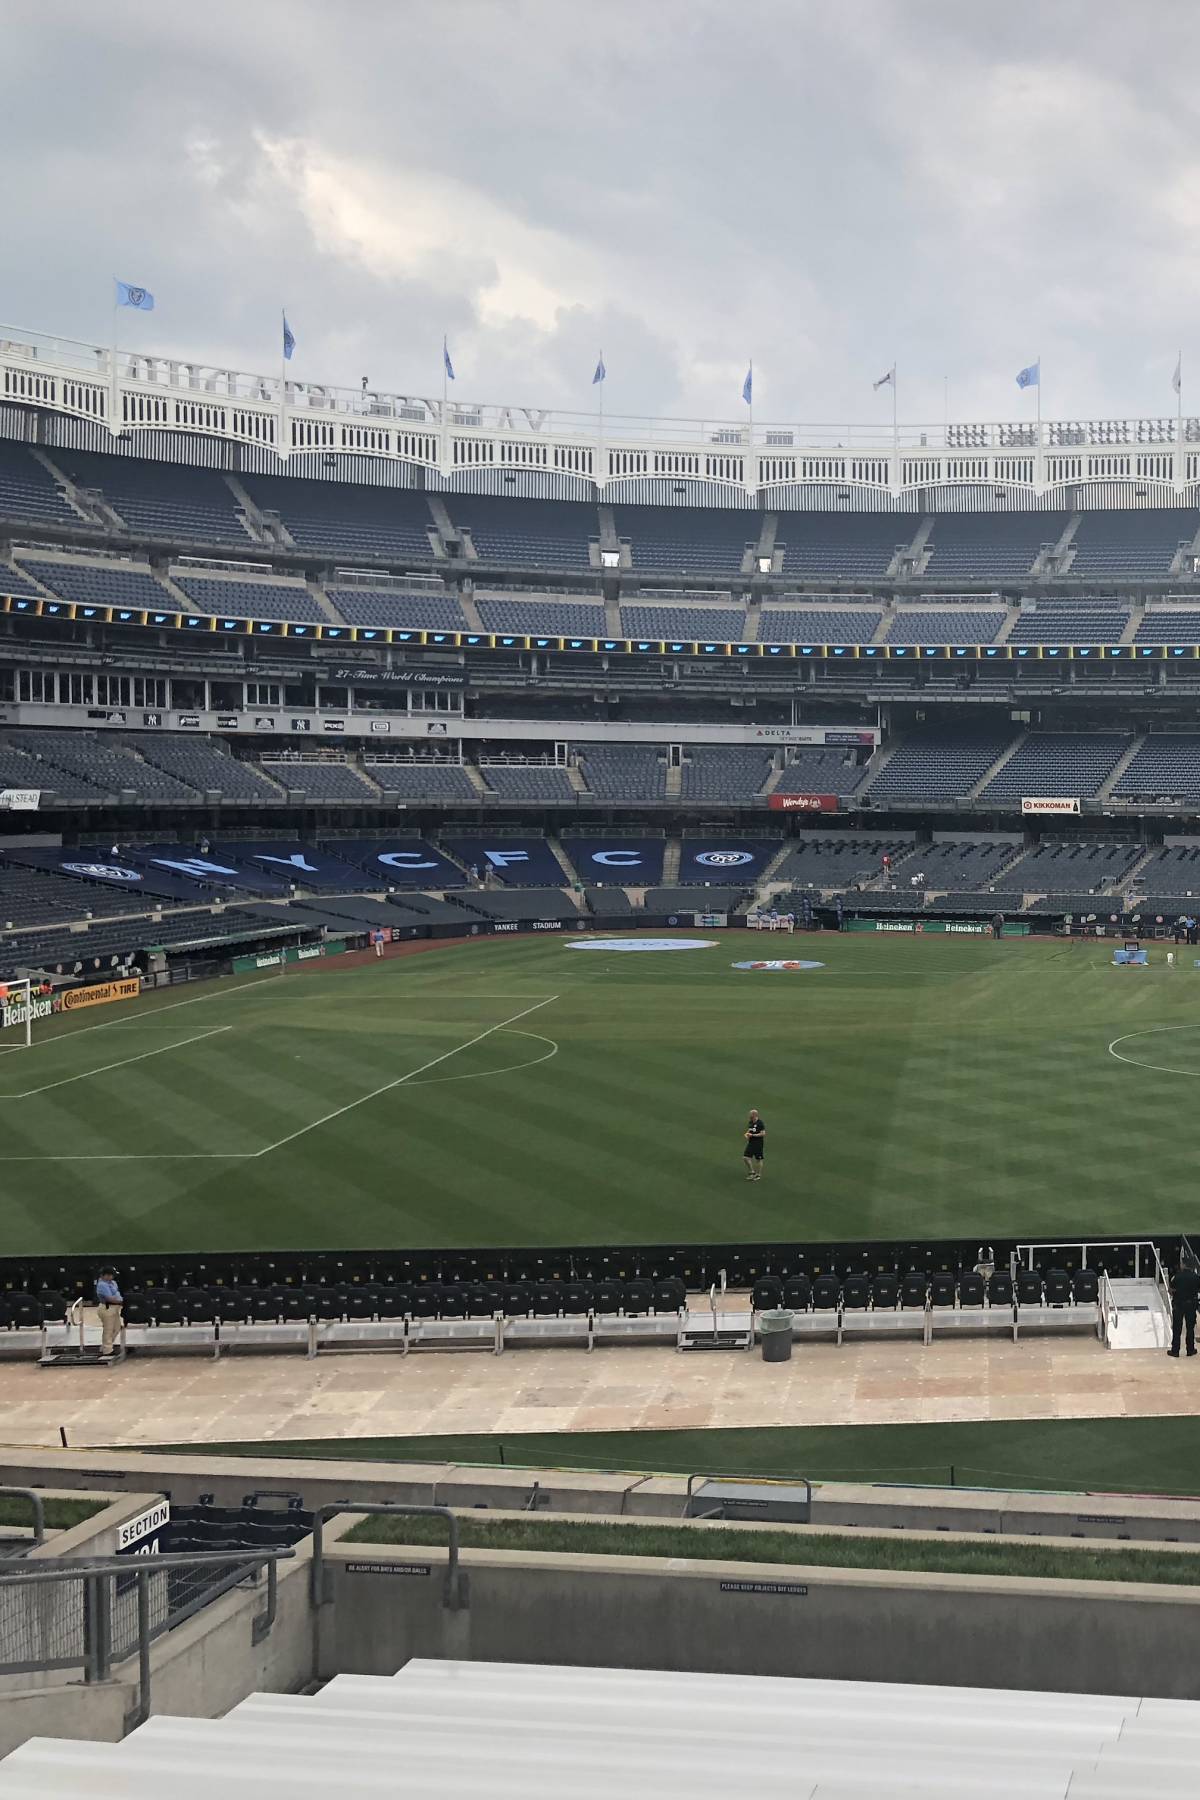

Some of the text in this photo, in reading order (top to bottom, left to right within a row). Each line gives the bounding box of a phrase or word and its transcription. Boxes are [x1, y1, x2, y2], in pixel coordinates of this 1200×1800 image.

[381, 672, 413, 681] World
[414, 673, 463, 684] Champions
[783, 797, 809, 807] Wendy's
[494, 921, 561, 931] YANKEE STADIUM
[876, 922, 912, 931] Heineken
[945, 924, 982, 932] Heineken
[64, 983, 136, 1008] Continental TIRE
[122, 1507, 167, 1543] SECTION
